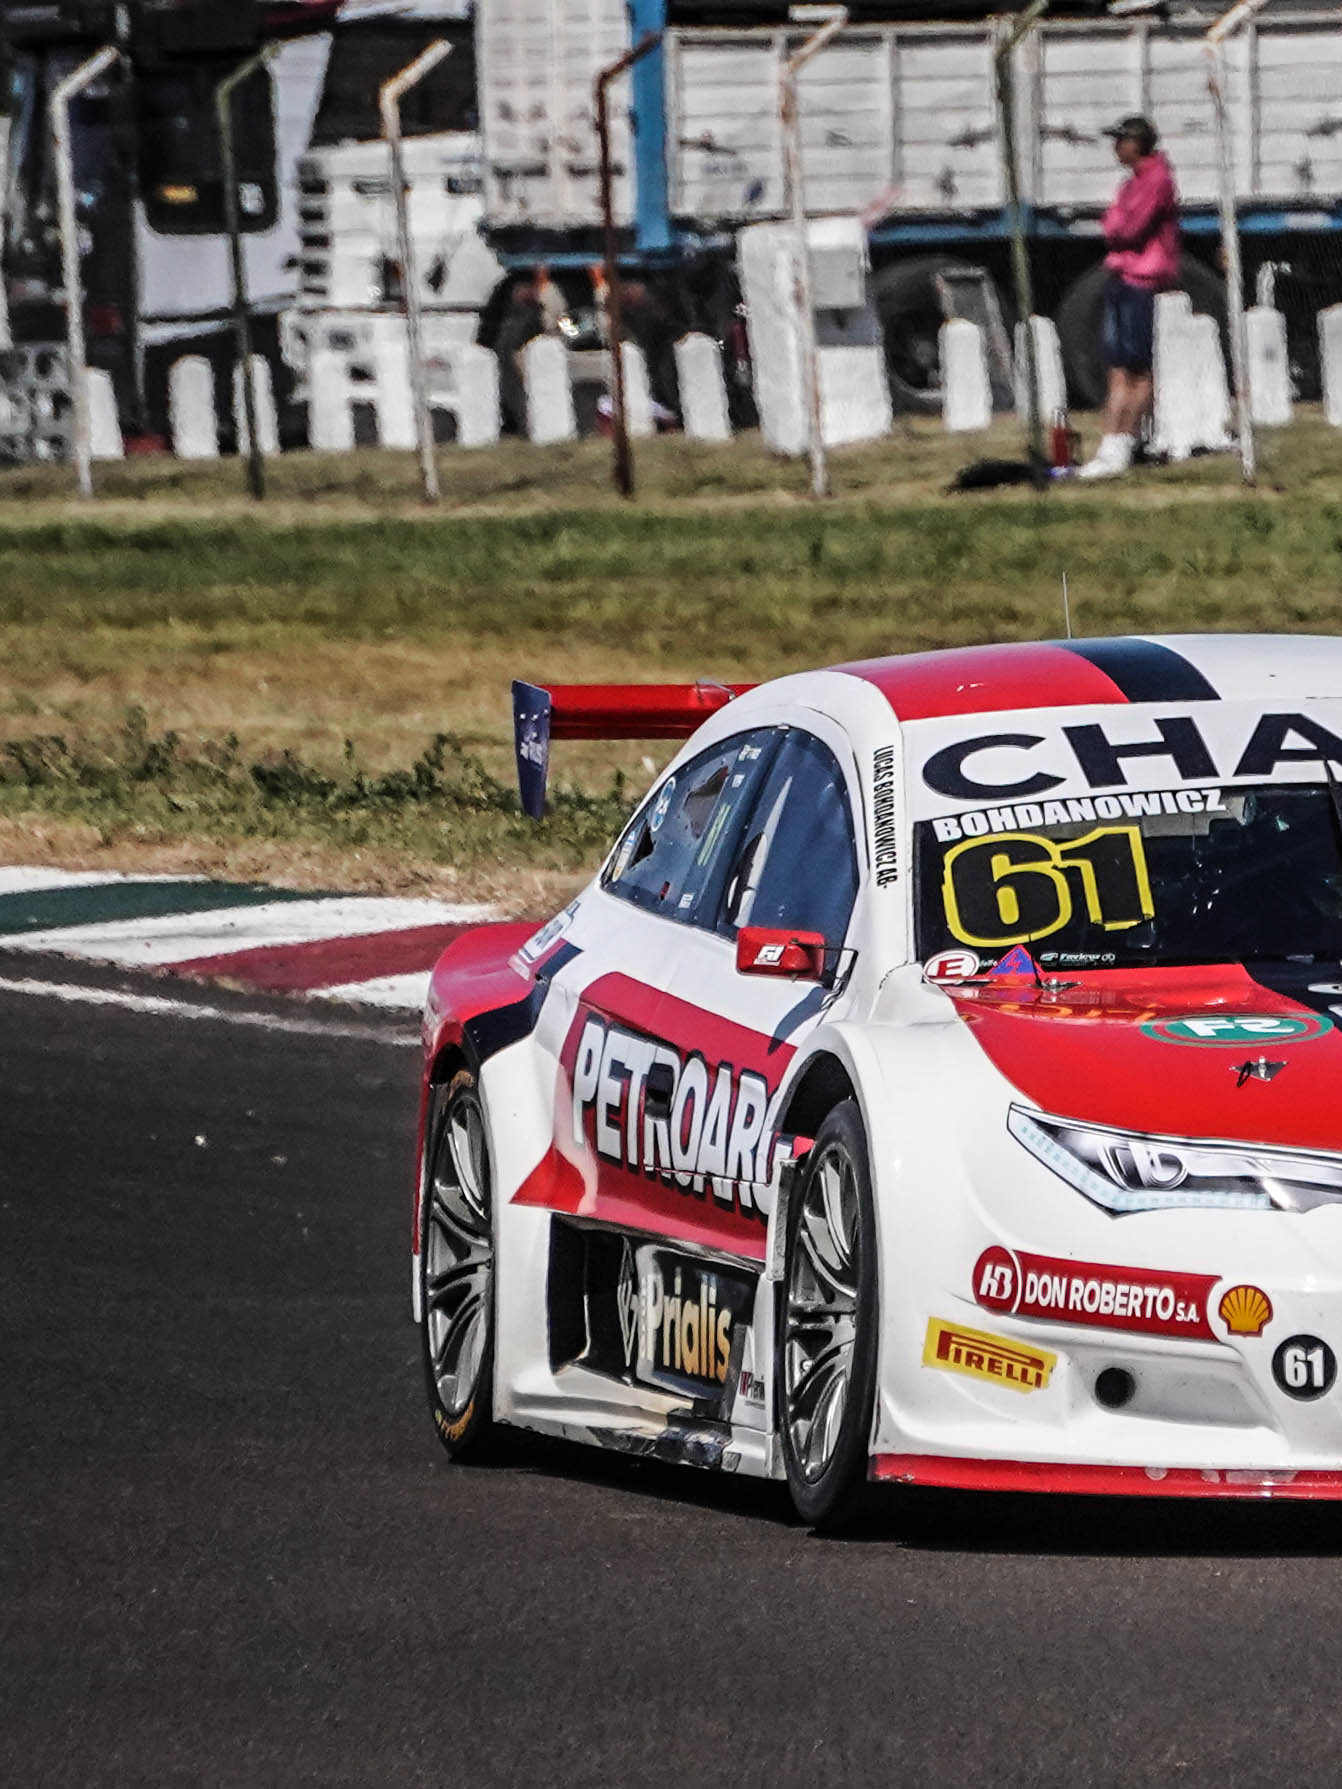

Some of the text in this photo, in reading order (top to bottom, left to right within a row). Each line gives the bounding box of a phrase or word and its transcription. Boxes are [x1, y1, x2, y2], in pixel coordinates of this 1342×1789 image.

[873, 745, 894, 783] LUCAS
[873, 780, 897, 869] BOHDANOWICZ
[932, 788, 1226, 843] BOHDANOWICZ
[942, 825, 1154, 948] 61
[645, 1266, 732, 1385] Prialis
[1025, 1272, 1201, 1323] DON ROBERTO S.A.
[937, 1330, 1045, 1389] PIRELLI
[1285, 1345, 1325, 1388] 61
